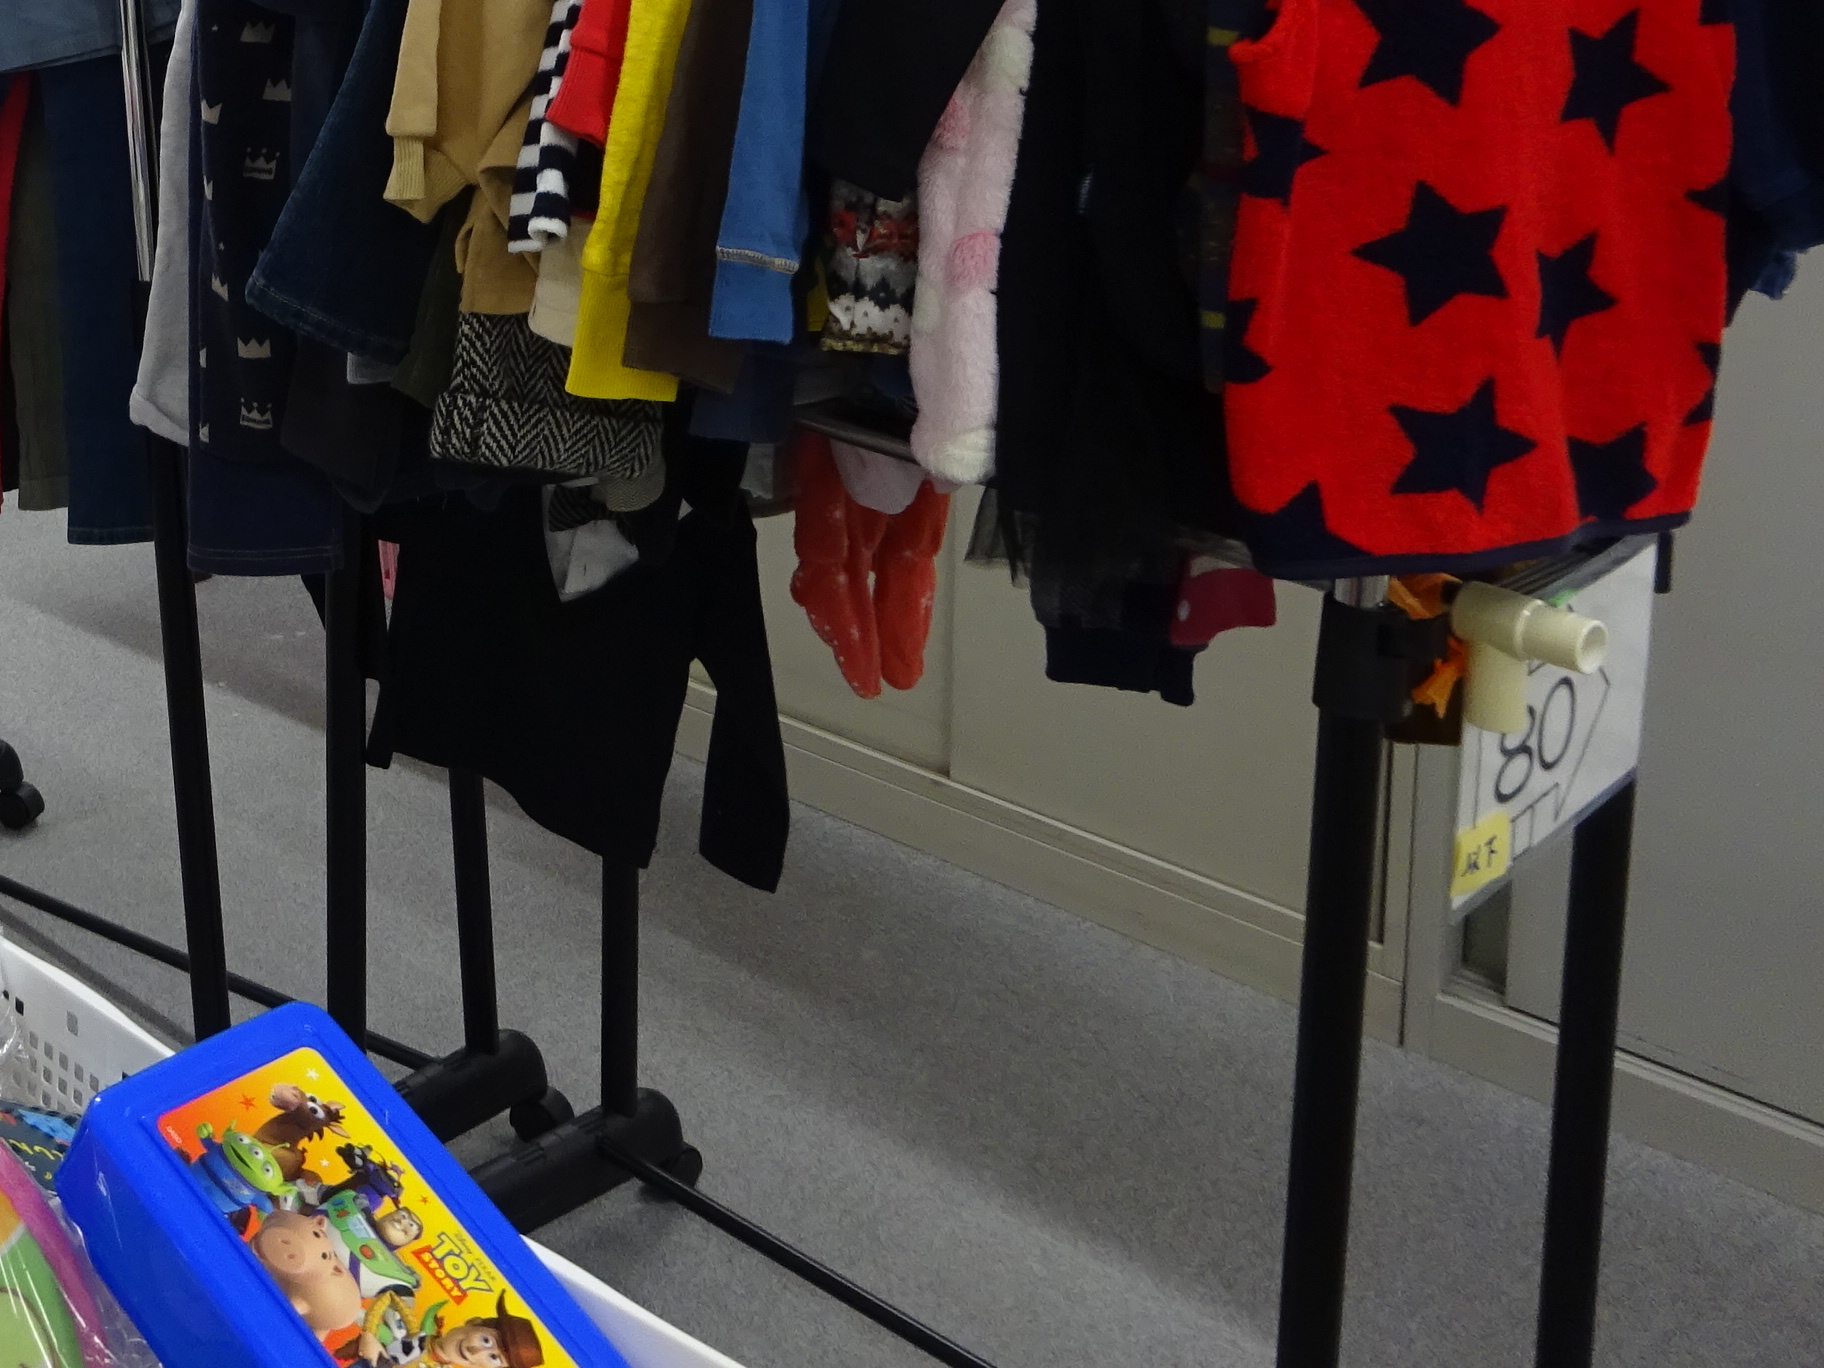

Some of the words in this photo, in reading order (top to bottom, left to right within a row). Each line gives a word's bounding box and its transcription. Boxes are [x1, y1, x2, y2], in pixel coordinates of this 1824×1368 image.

[1494, 675, 1575, 804] 80
[419, 1251, 461, 1299] STORY
[431, 1232, 494, 1294] TOY
